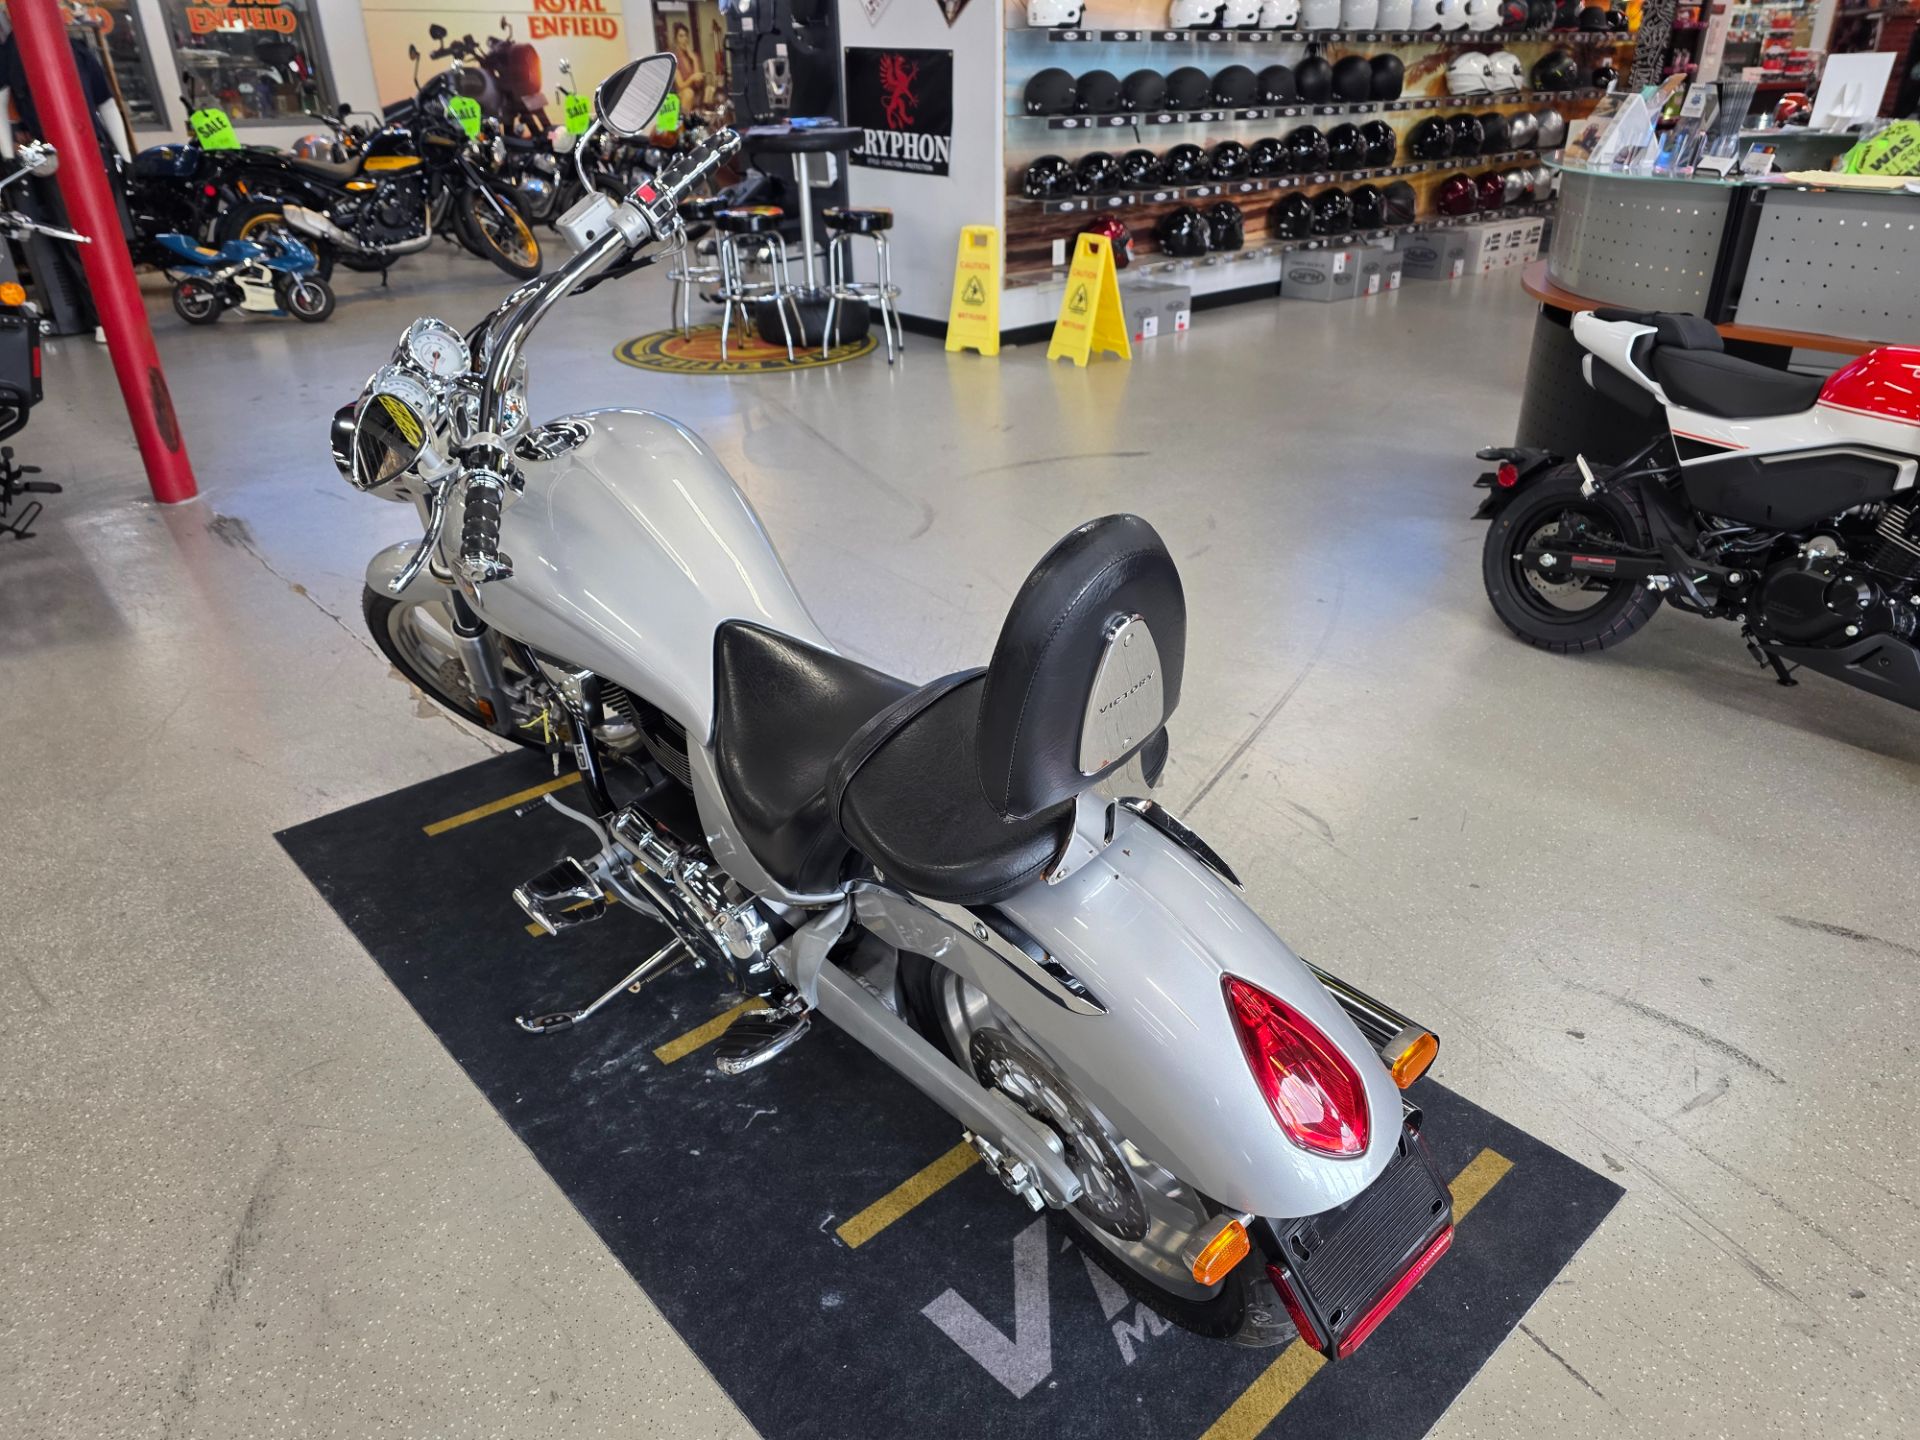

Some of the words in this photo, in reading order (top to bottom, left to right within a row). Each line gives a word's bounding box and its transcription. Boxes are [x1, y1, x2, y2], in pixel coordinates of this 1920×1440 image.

[186, 7, 297, 34] ENFIELD
[527, 15, 618, 39] ENFIELD
[197, 116, 227, 139] SALE
[1870, 134, 1915, 171] WAS
[959, 260, 990, 271] CAUTION
[1099, 669, 1155, 714] VICTORY
